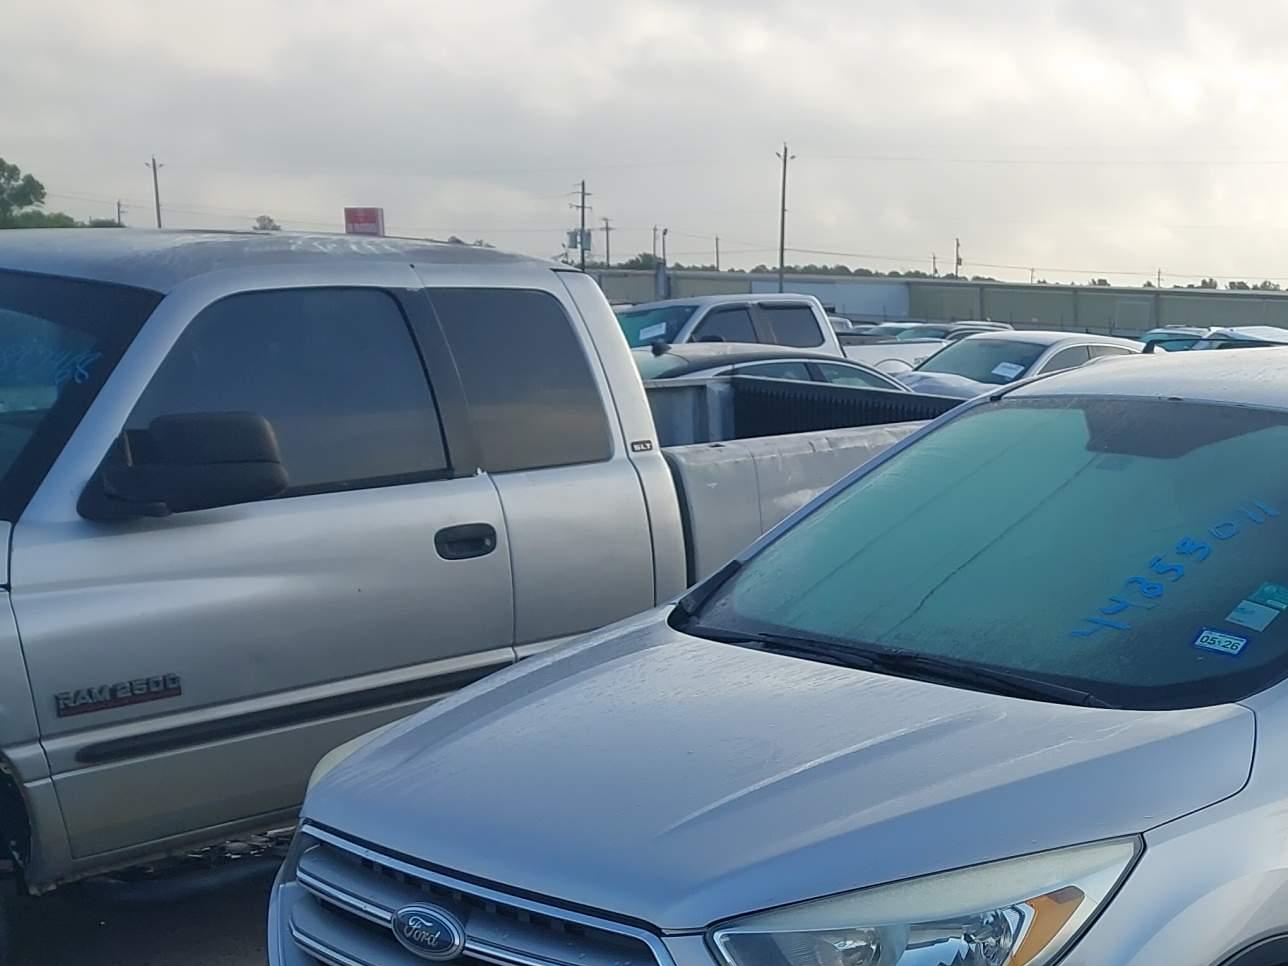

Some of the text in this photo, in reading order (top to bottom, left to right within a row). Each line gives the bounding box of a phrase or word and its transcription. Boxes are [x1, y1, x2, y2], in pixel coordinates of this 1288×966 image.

[1200, 635, 1241, 651] 05 26
[54, 672, 181, 709] RAM 2500
[403, 916, 441, 947] Ford
